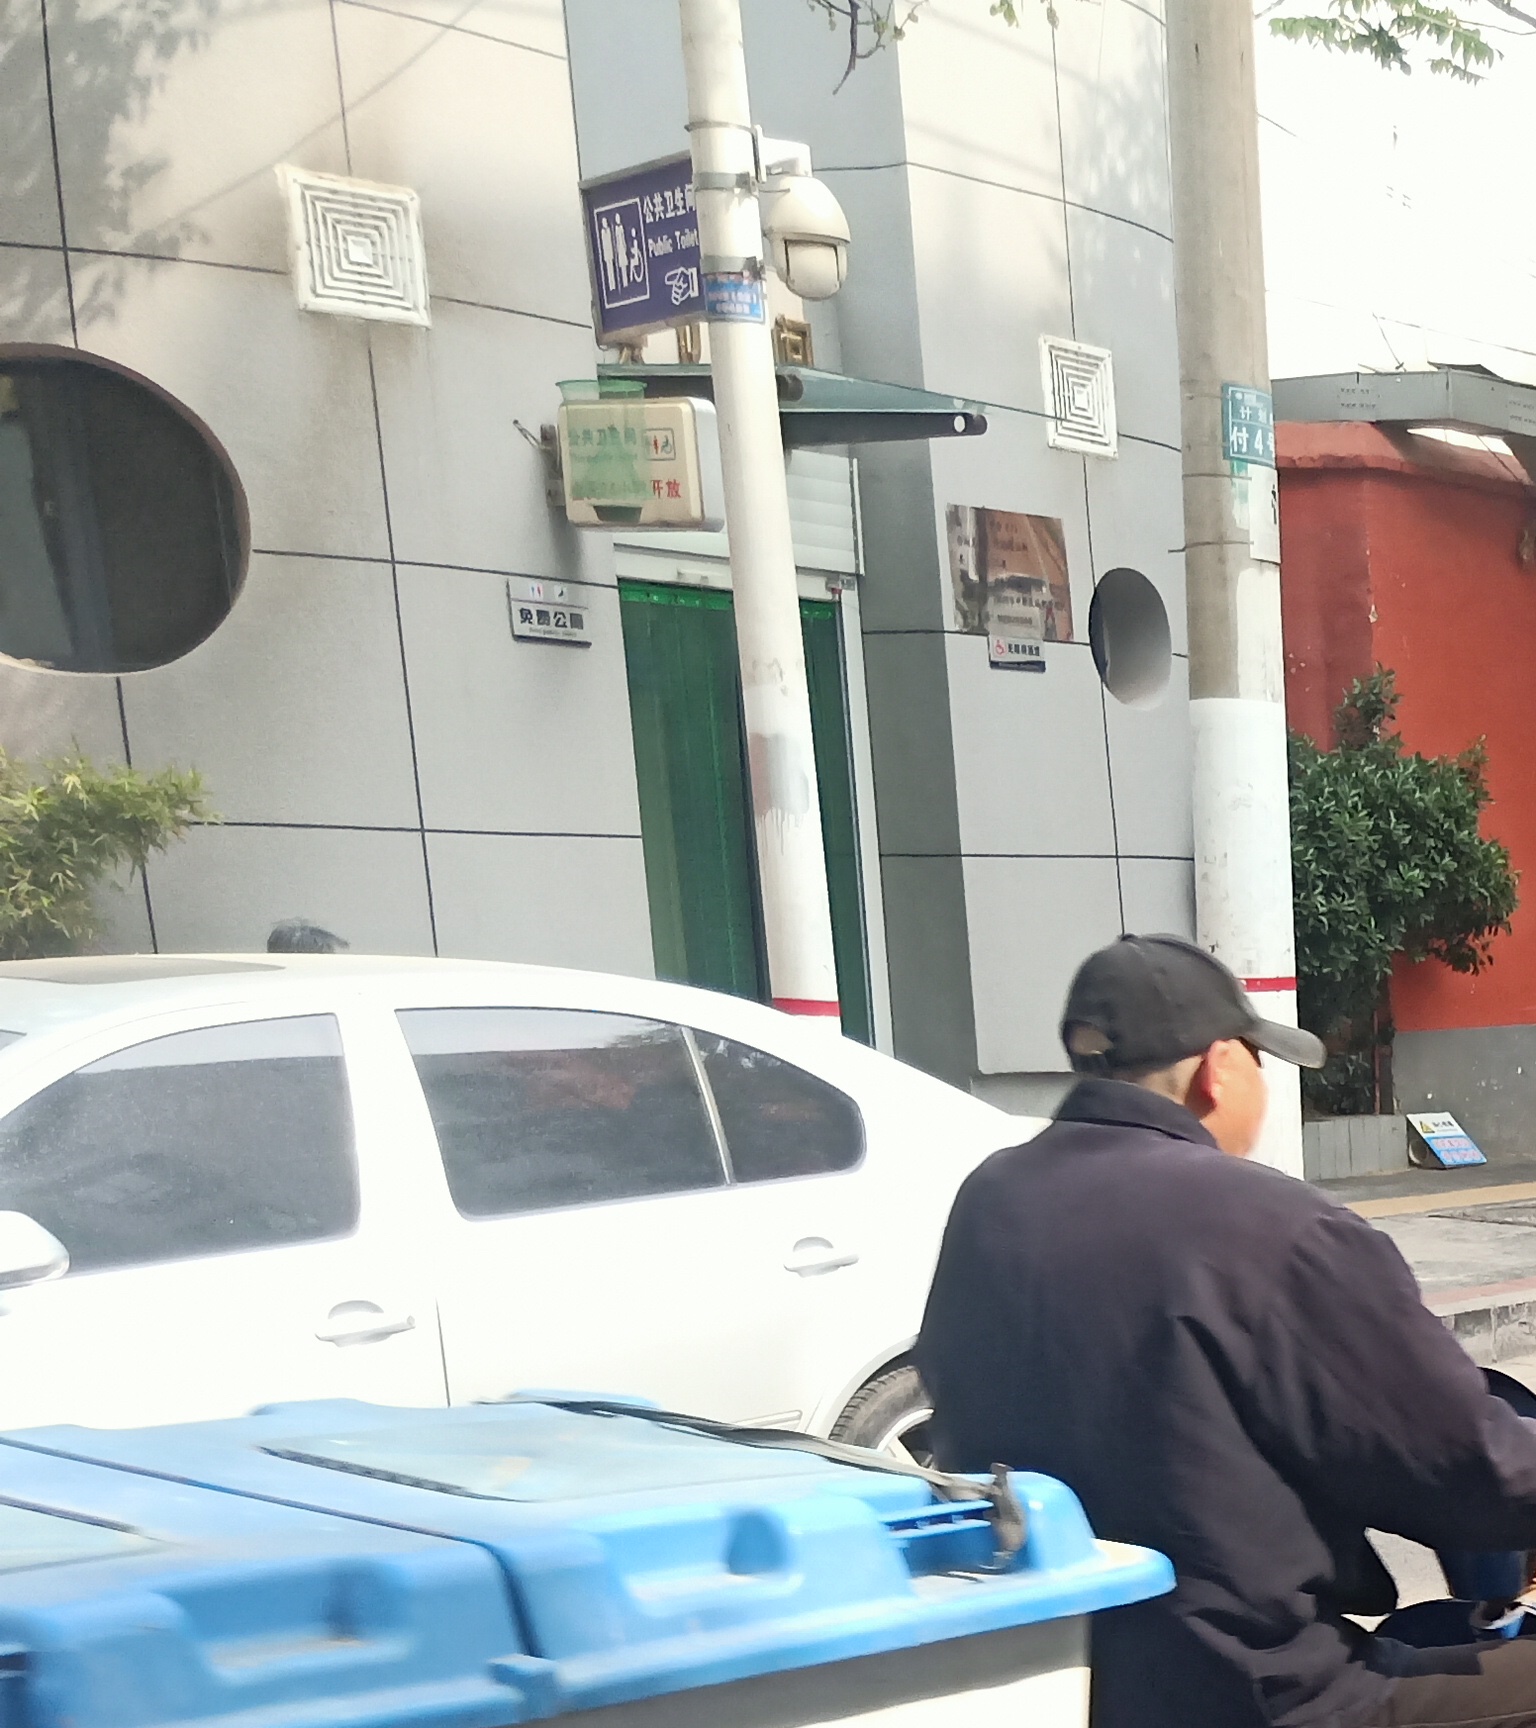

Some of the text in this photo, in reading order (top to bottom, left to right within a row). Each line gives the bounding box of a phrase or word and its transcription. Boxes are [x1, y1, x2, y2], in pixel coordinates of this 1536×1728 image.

[643, 183, 697, 224] 公共卫生间
[648, 227, 699, 258] Public Toilet
